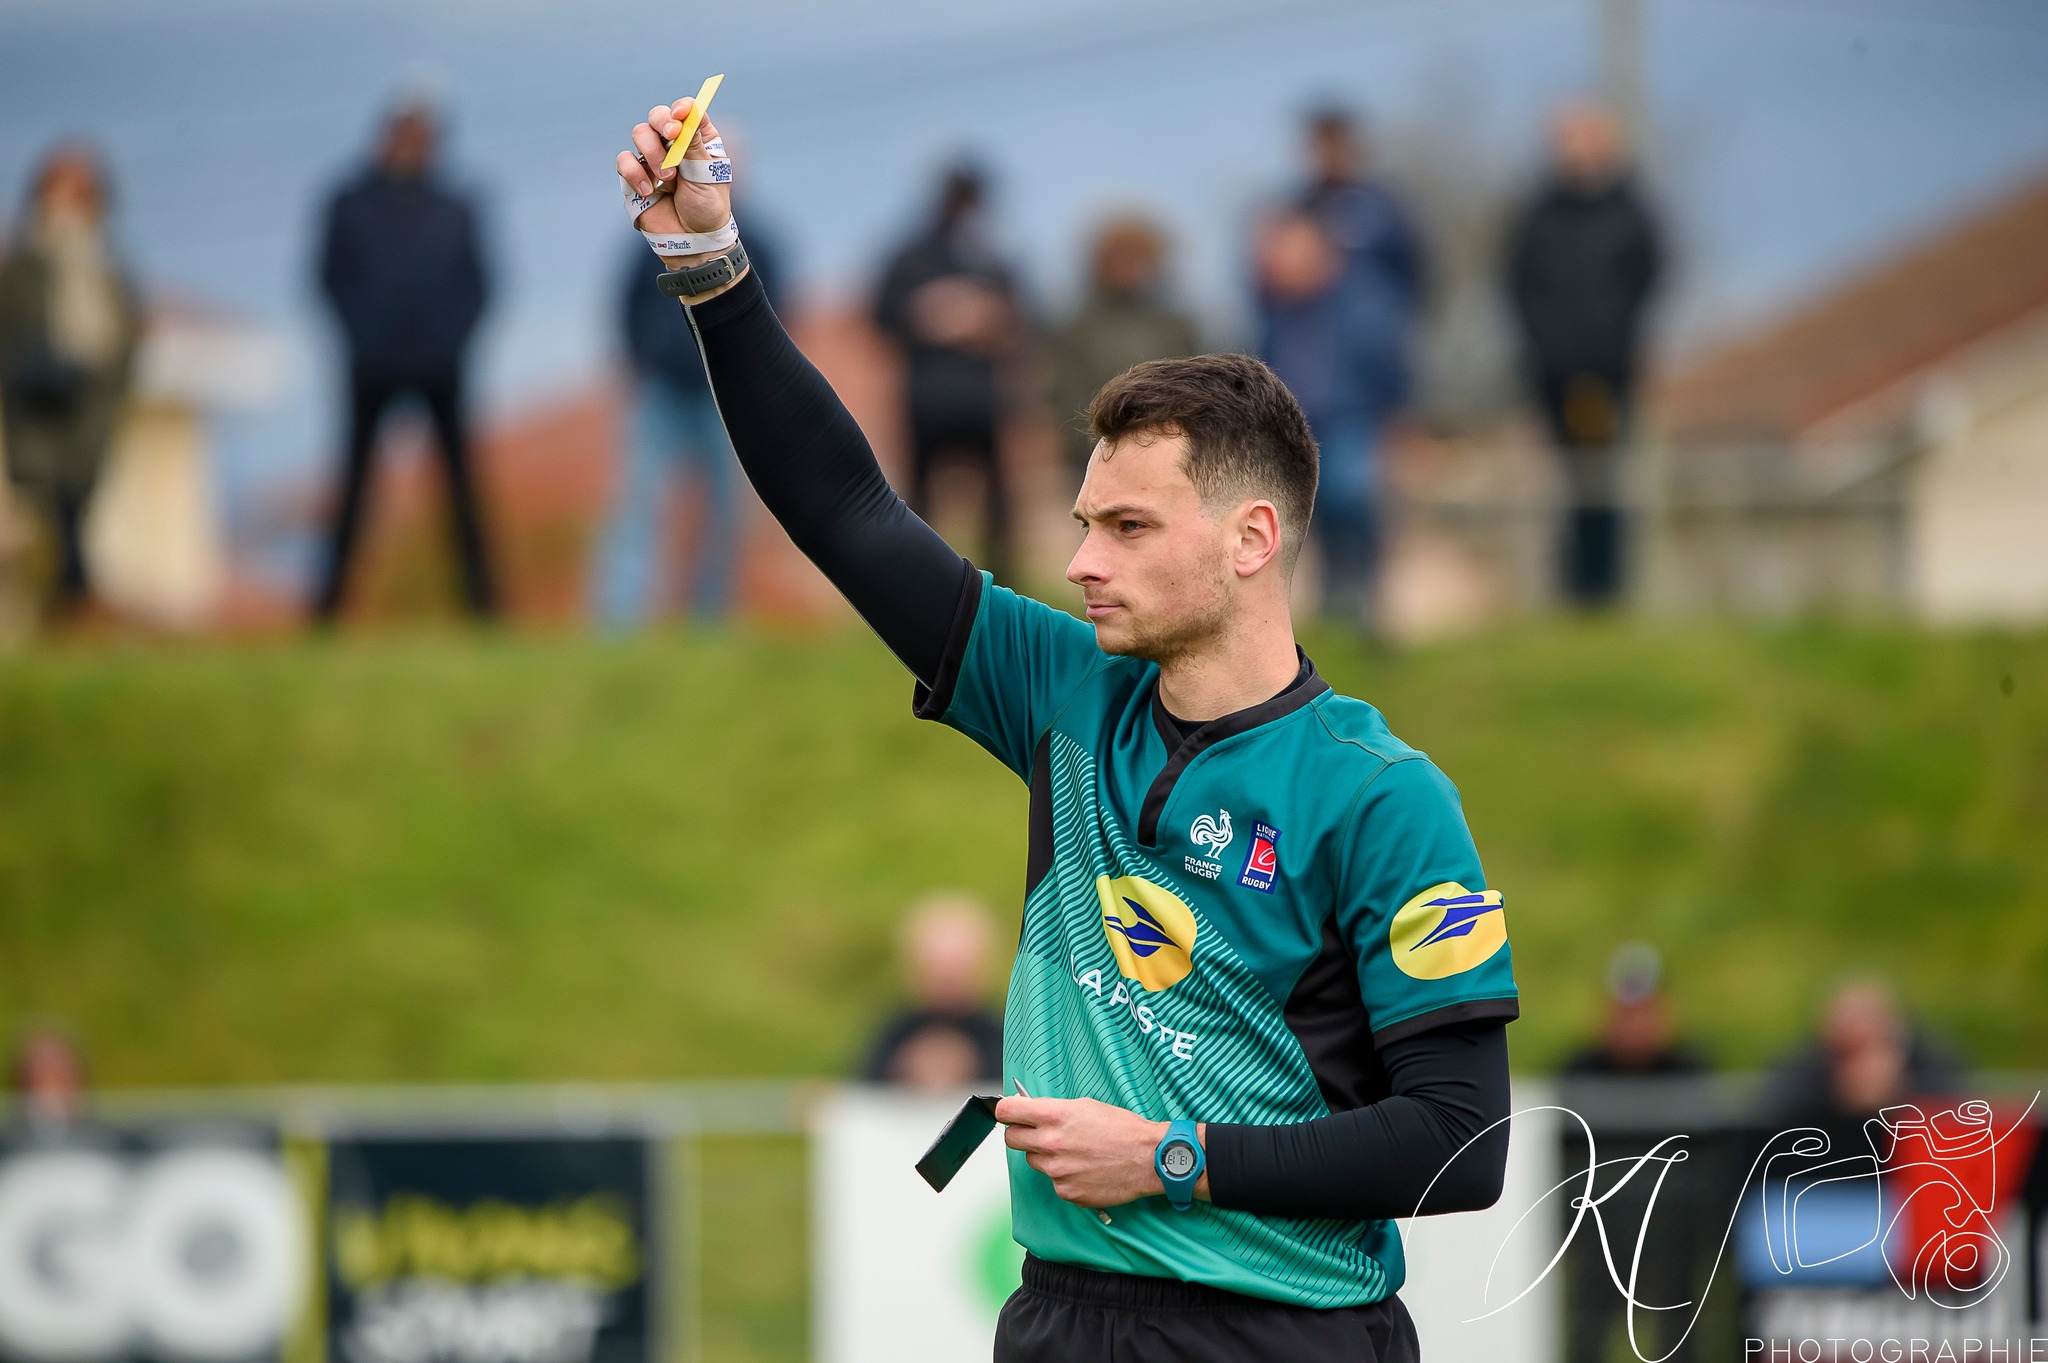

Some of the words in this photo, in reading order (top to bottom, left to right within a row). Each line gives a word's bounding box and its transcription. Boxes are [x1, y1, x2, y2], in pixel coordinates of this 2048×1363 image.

[1257, 823, 1277, 839] LIGUE
[1184, 863, 1220, 881] RUGBY
[1185, 856, 1223, 872] FRANCE
[1241, 876, 1272, 891] RUGBY
[1070, 953, 1102, 997] LA
[1108, 981, 1198, 1061] POSTE
